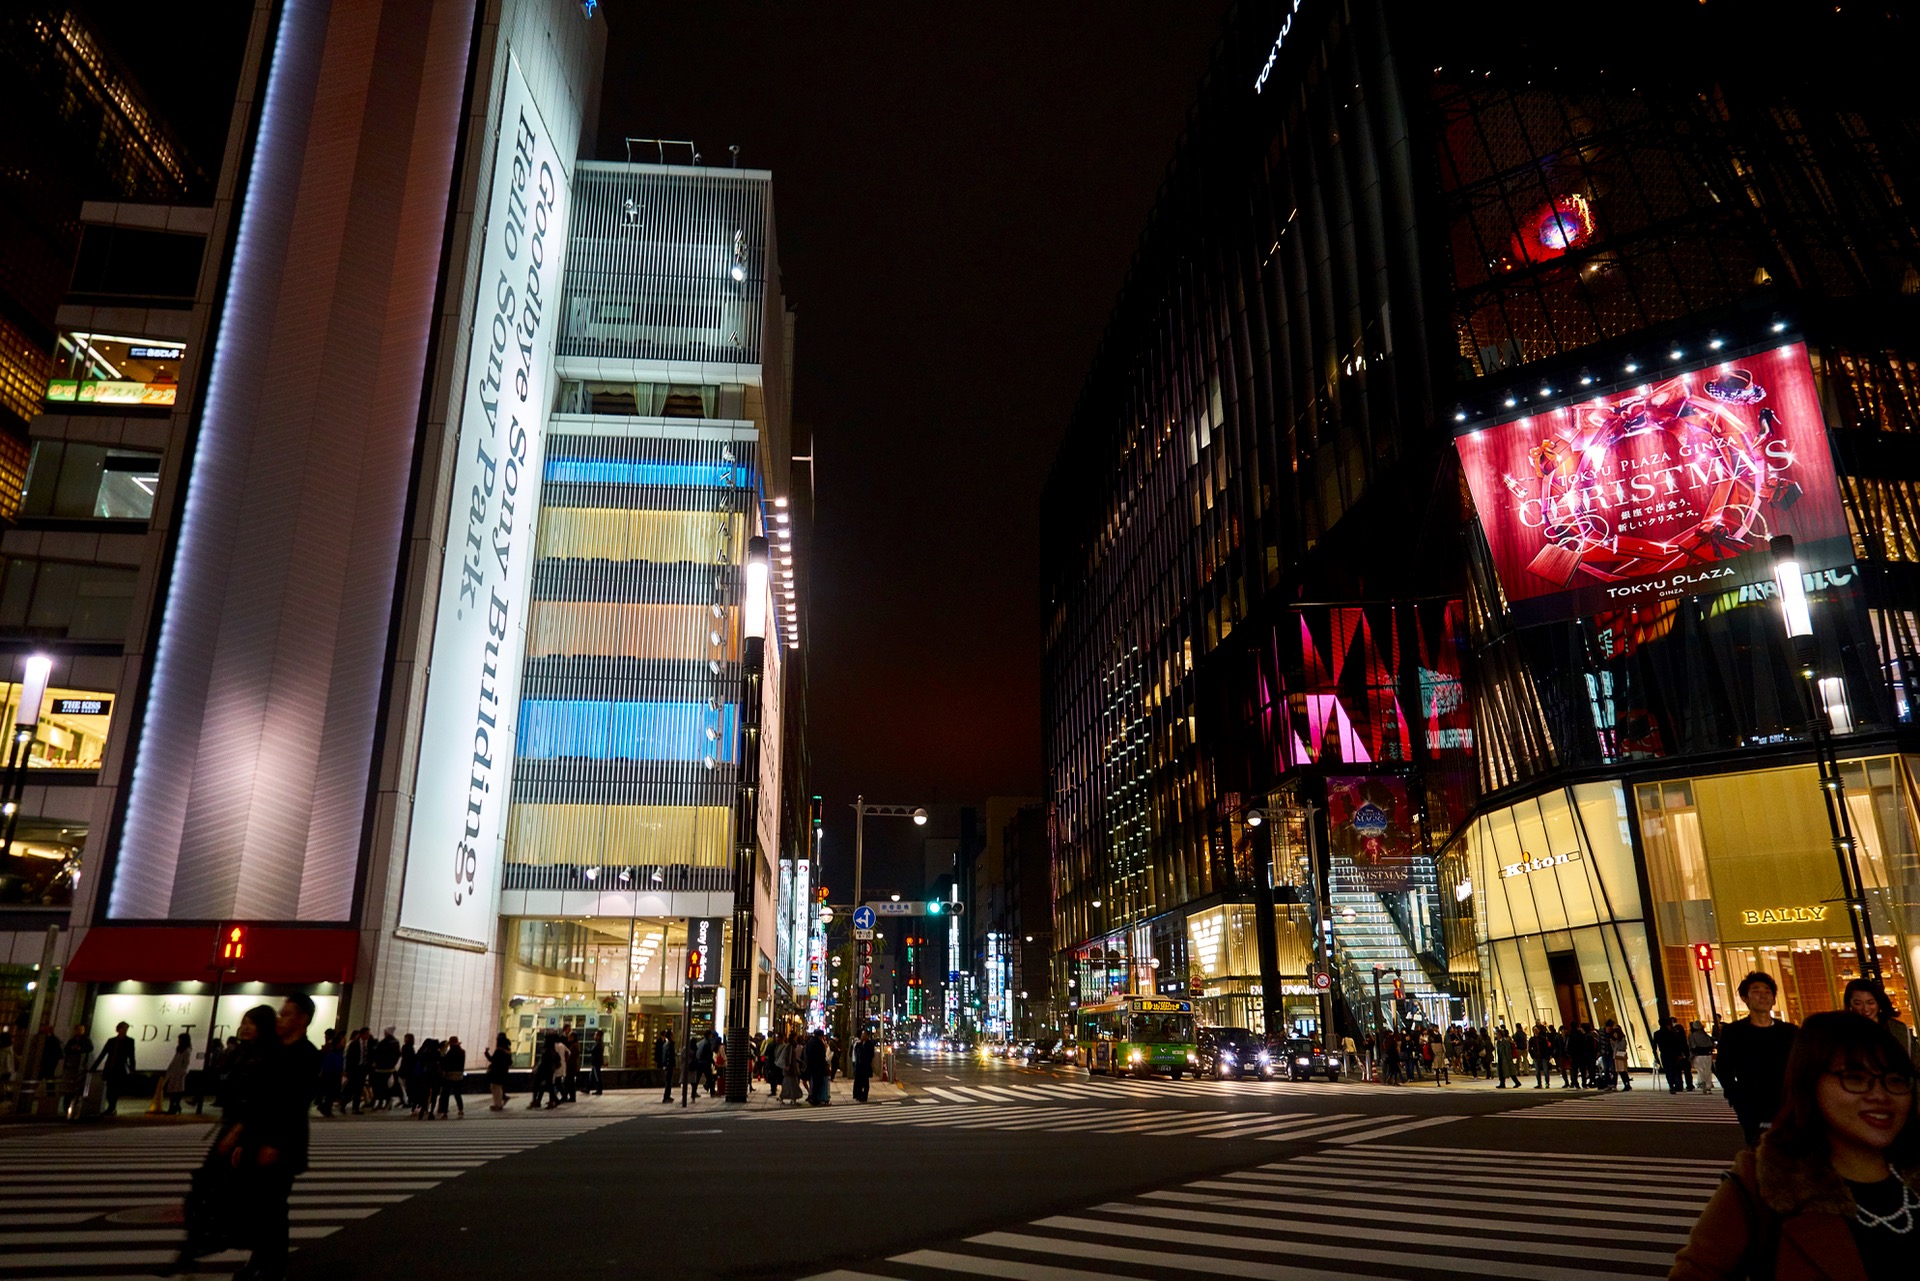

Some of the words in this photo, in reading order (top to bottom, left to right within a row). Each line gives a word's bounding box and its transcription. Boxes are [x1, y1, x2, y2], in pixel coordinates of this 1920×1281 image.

[1254, 13, 1291, 94] TOKYU
[504, 104, 535, 261] Hello
[515, 161, 556, 403] Goodbye
[479, 269, 516, 438] Sony
[1518, 439, 1794, 528] CHRISTMAS
[1557, 465, 1611, 487] TOKYU
[1620, 452, 1671, 471] PLAZA
[1679, 435, 1738, 457] GINZA
[457, 438, 497, 621] Park.
[492, 414, 527, 581] Sony
[1606, 579, 1666, 598] TOKYU
[1672, 567, 1735, 585] PLAZA
[1659, 588, 1684, 597] GINZA
[62, 700, 81, 709] THE
[81, 701, 101, 710] KISS
[454, 584, 509, 906] Building,
[1504, 852, 1569, 877] Kiton
[697, 920, 709, 944] Sony
[1743, 906, 1825, 924] BALLY
[127, 1024, 197, 1042] DIT
